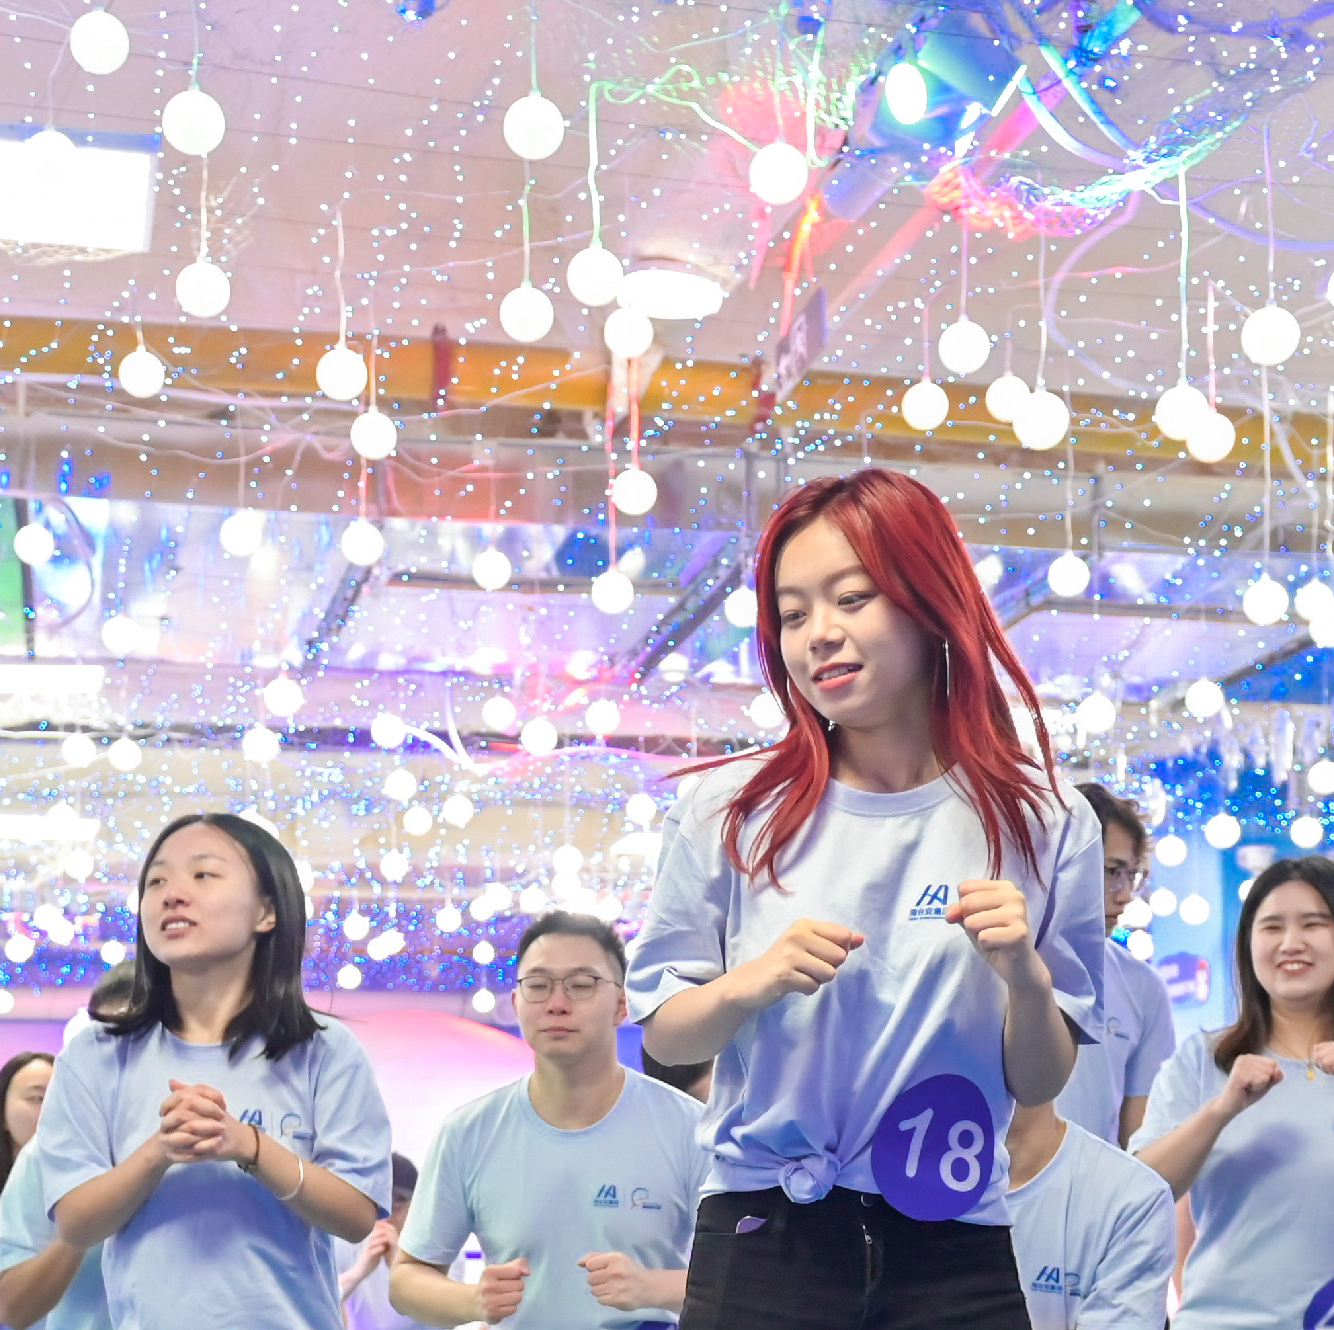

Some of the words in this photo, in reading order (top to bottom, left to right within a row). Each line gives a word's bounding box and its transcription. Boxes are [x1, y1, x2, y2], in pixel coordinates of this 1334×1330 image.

[909, 907, 946, 917] 海合安集
[898, 1107, 985, 1193] 18
